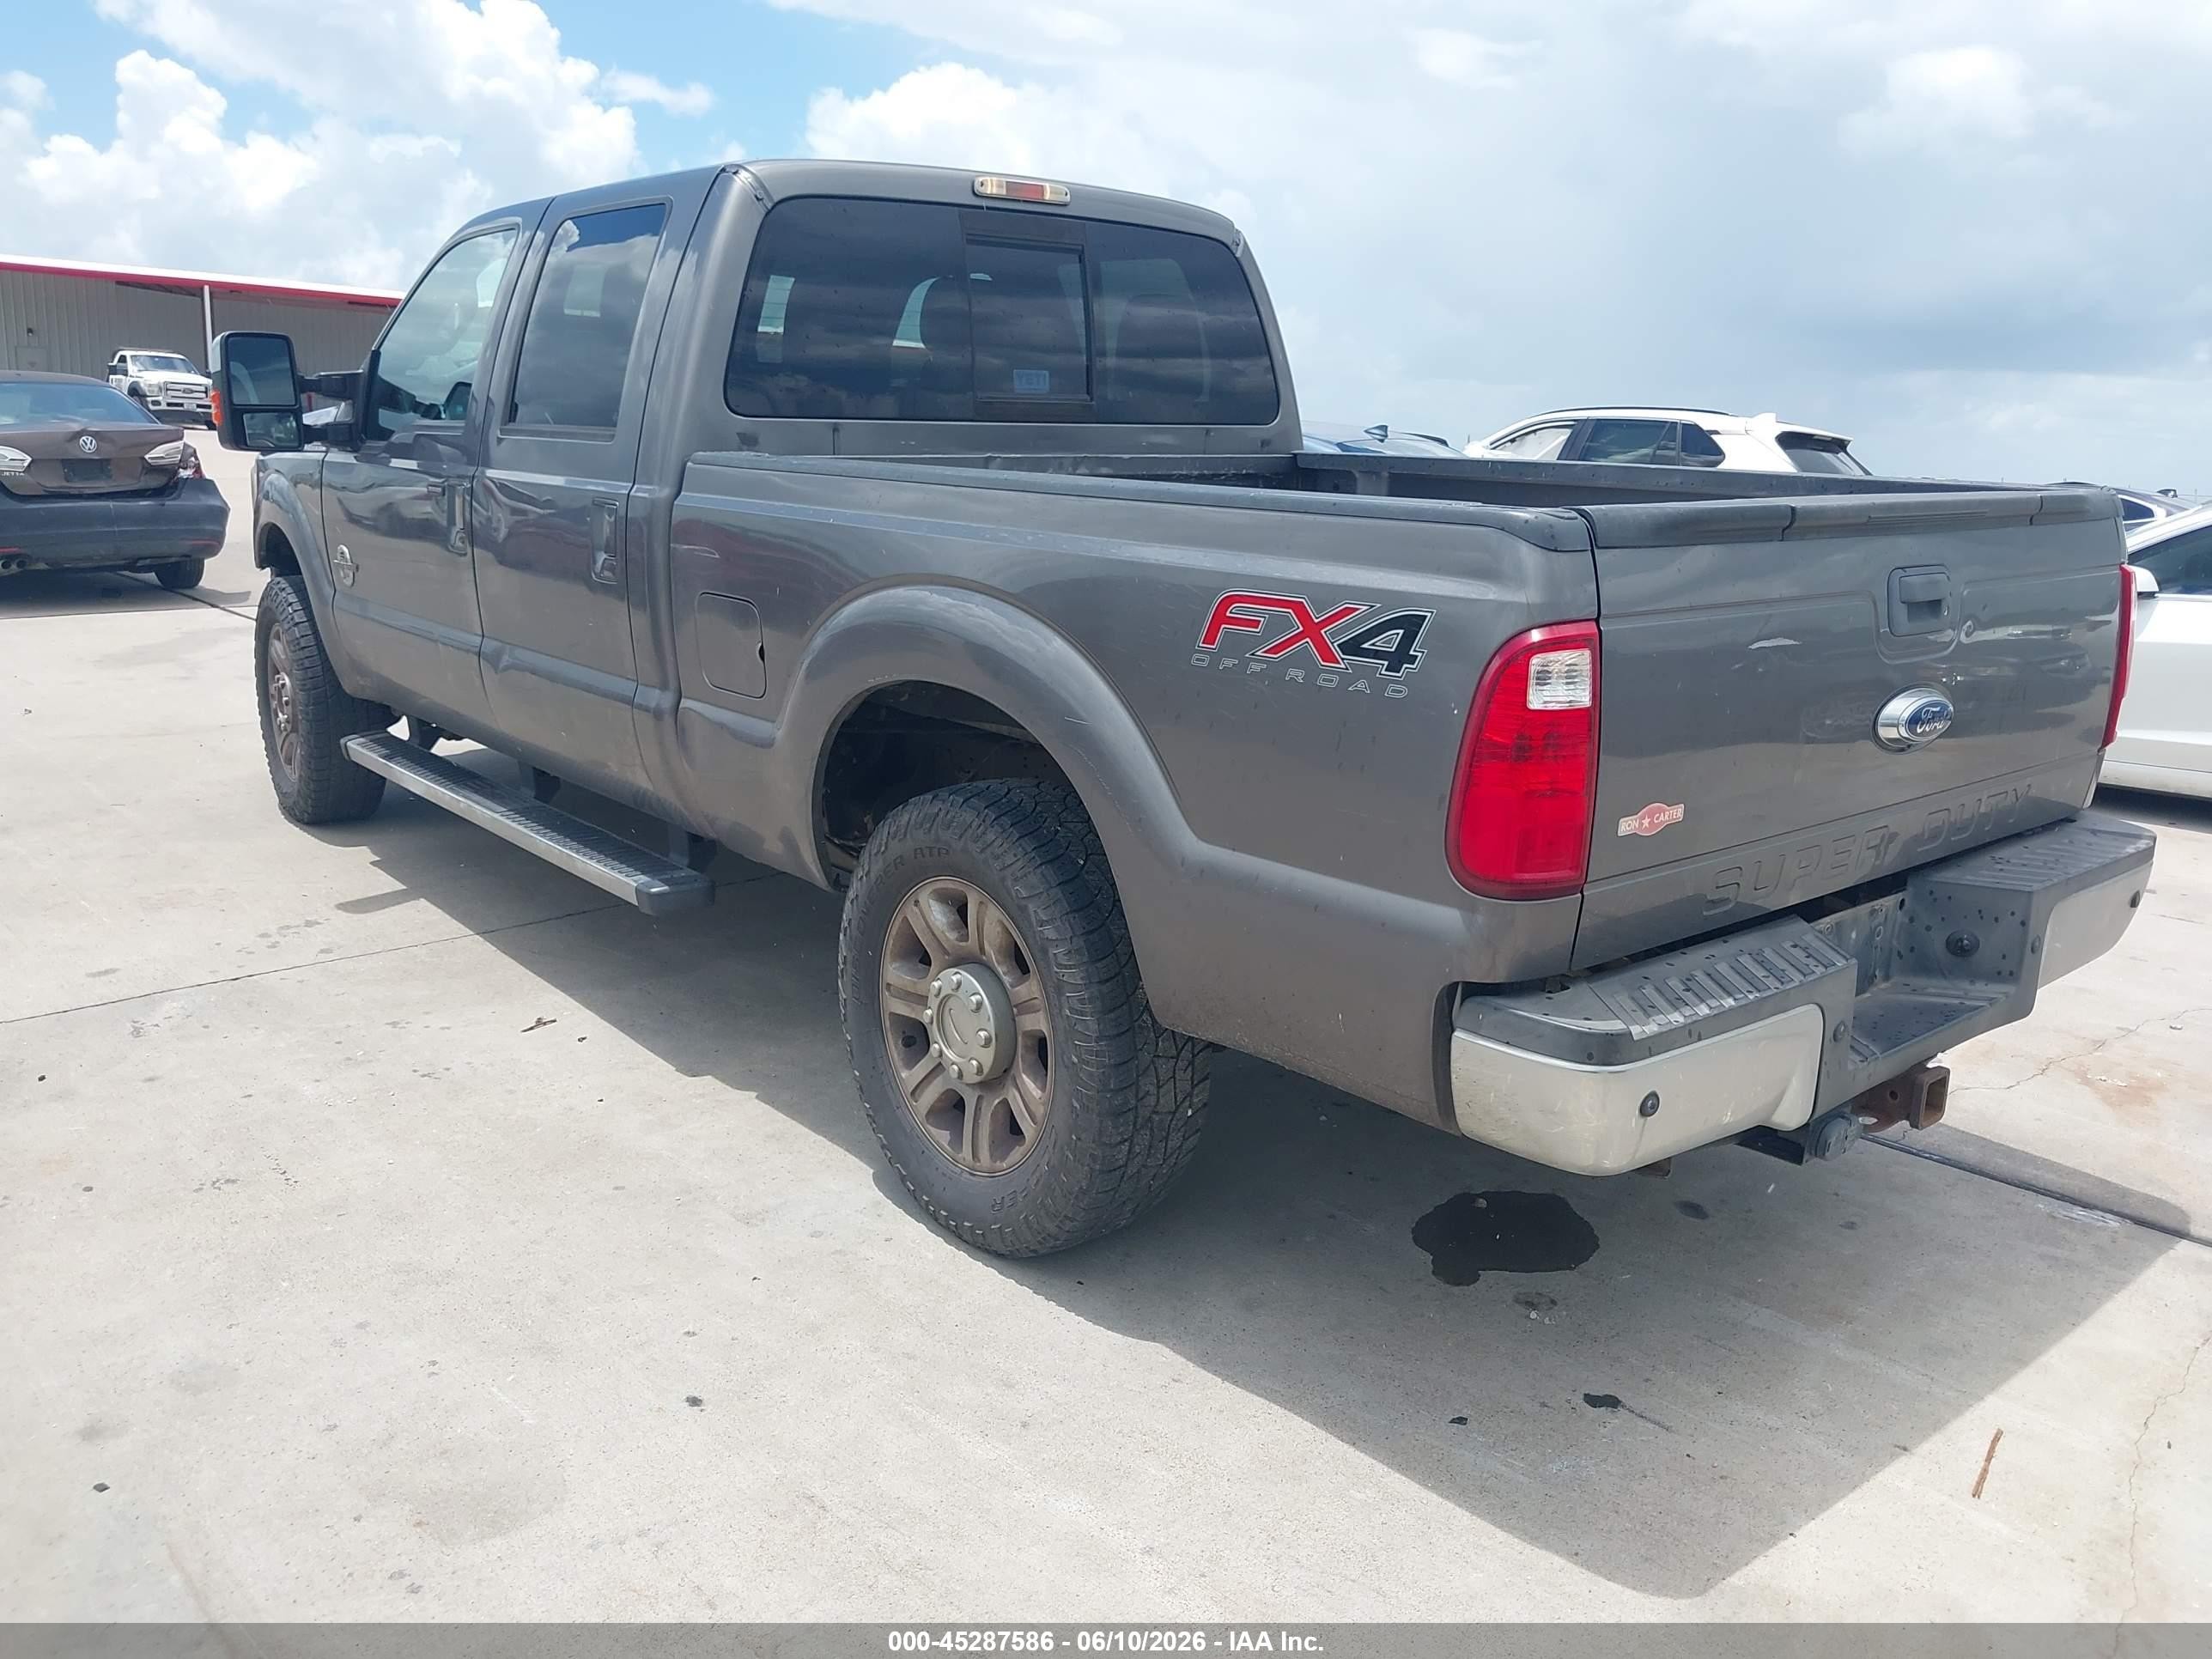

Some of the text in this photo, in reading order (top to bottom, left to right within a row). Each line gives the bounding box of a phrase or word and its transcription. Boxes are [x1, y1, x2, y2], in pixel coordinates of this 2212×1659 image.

[1194, 588, 1437, 681] FX4
[1620, 808, 1682, 833] RON CARTER
[1702, 784, 2032, 916] SUPER DUTY
[914, 846, 950, 860] ATP
